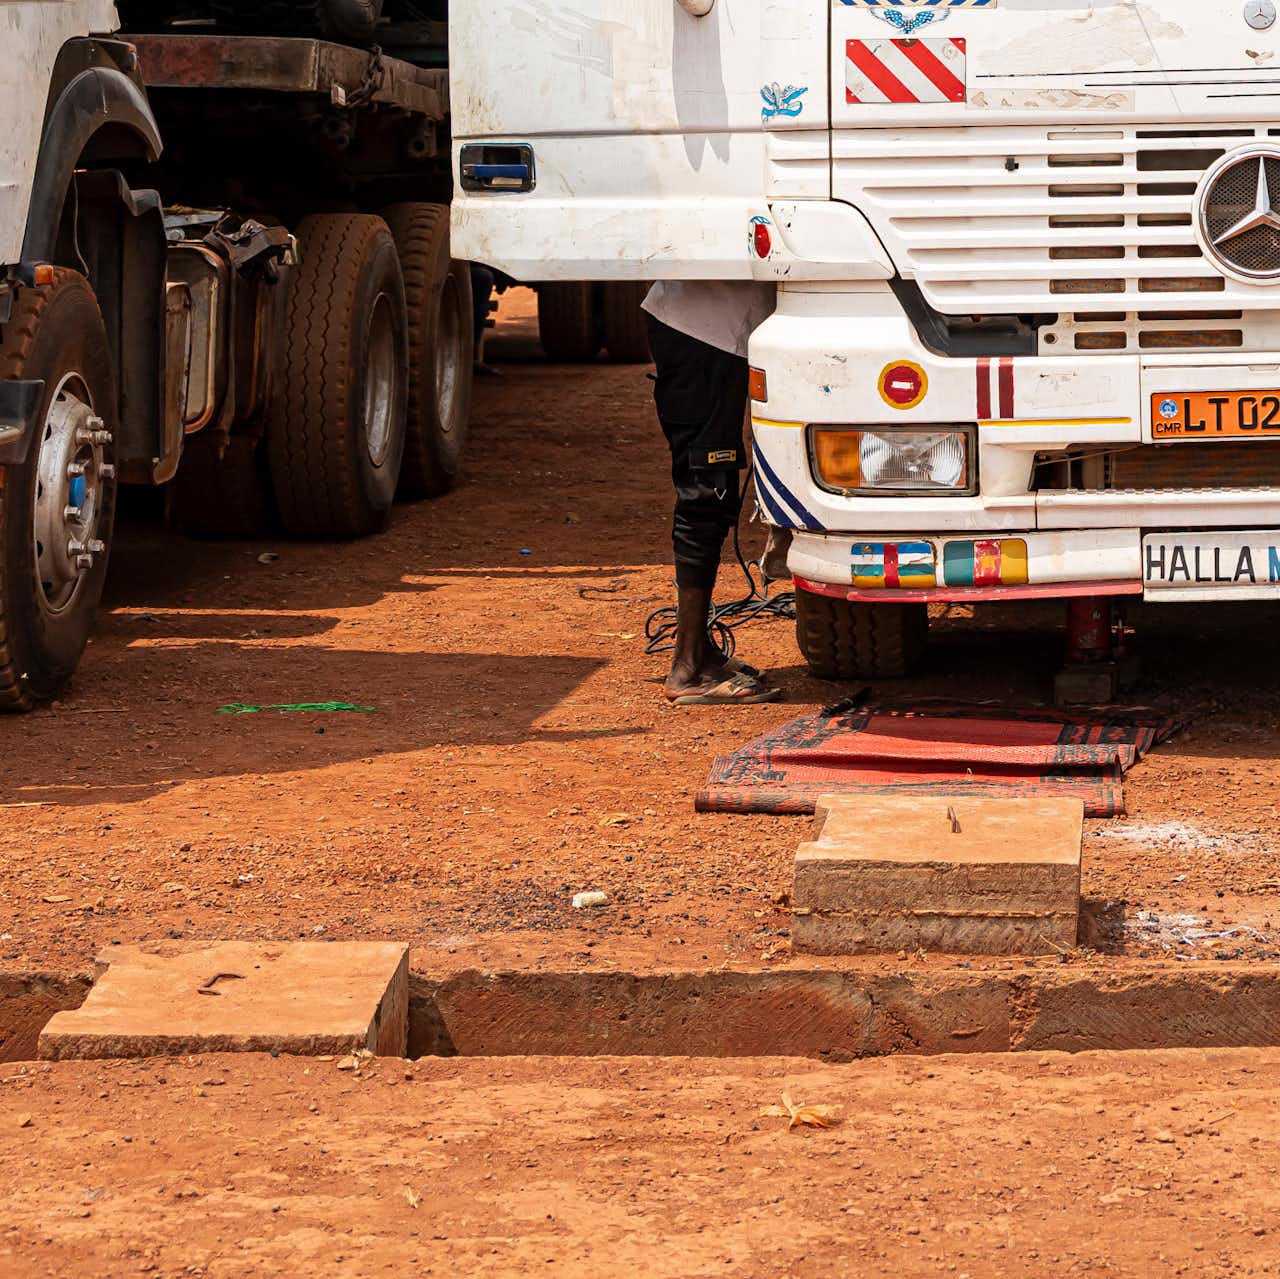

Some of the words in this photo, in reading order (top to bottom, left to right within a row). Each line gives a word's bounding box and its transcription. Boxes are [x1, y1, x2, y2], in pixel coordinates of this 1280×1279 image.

[1155, 422, 1182, 433] CMR
[1183, 397, 1230, 431] LT
[1145, 544, 1257, 584] HALLA
